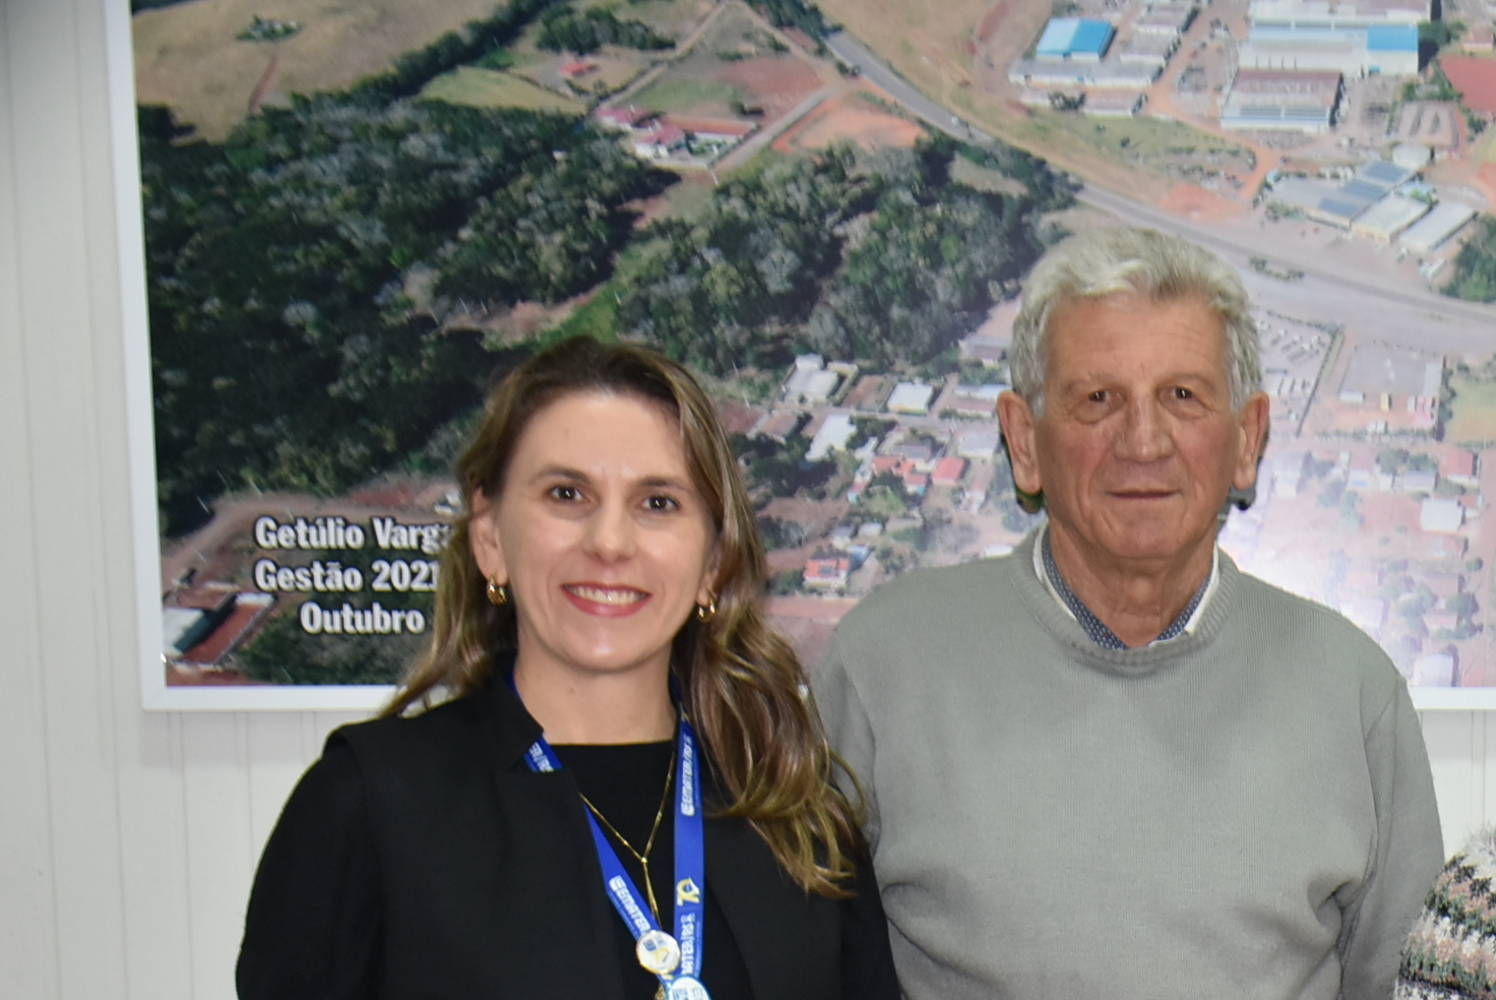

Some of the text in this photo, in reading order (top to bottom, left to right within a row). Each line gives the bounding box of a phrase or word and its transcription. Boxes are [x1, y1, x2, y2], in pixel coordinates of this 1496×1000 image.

[254, 515, 365, 550] Getúlio
[254, 558, 440, 592] Gestão 2021
[299, 601, 426, 634] Outubro
